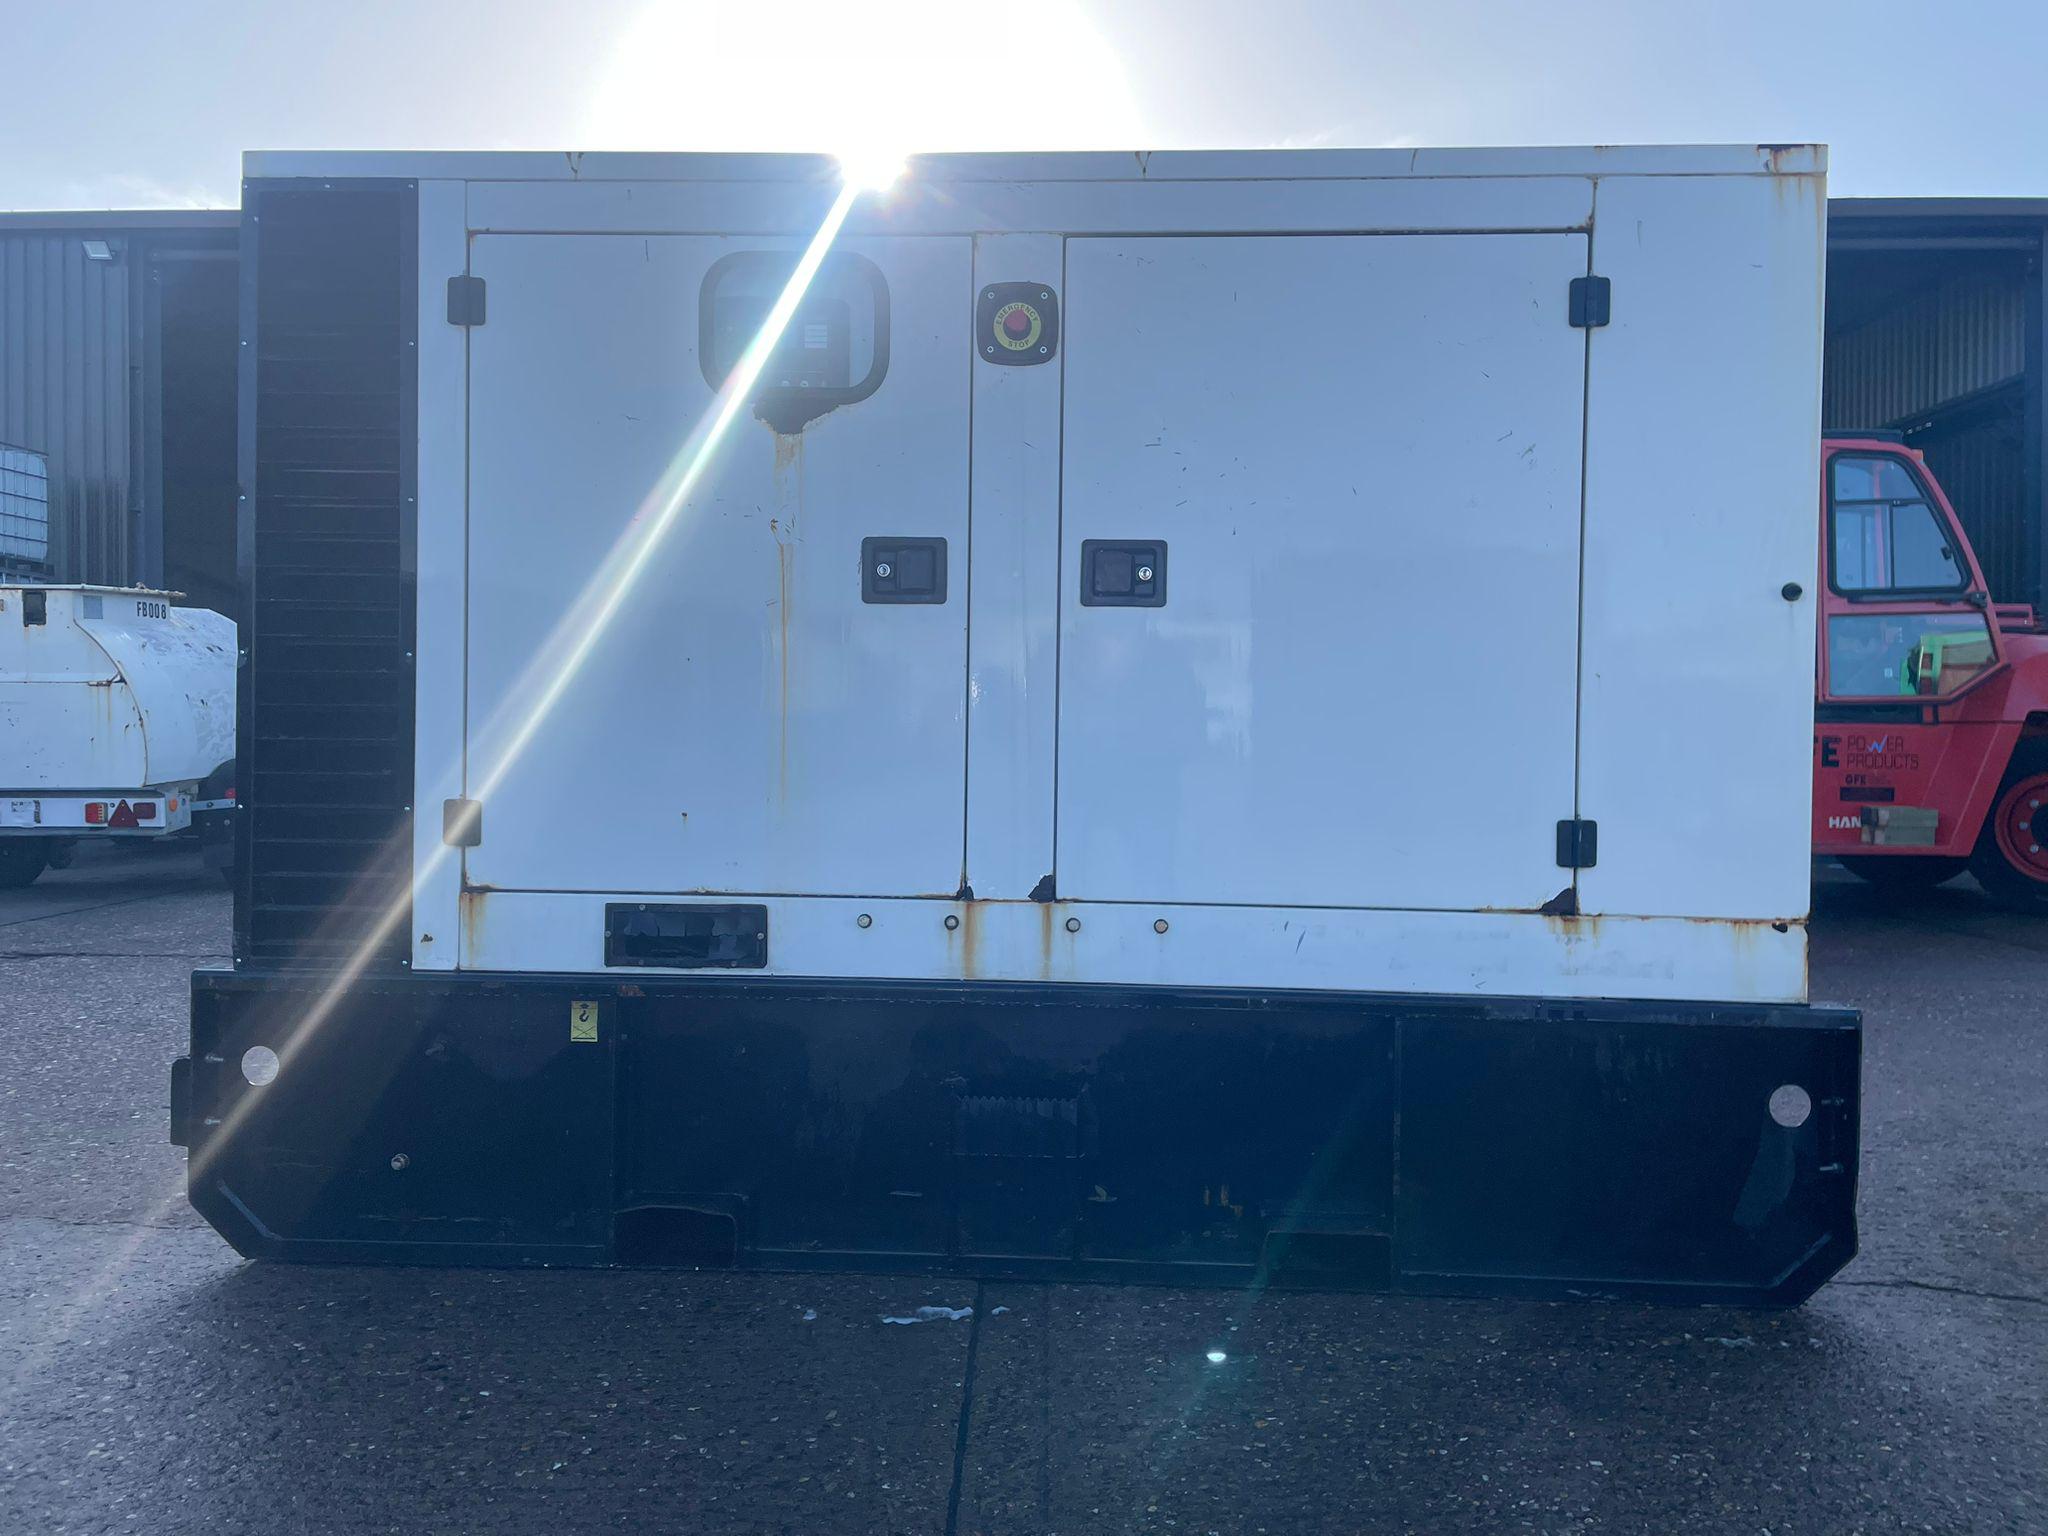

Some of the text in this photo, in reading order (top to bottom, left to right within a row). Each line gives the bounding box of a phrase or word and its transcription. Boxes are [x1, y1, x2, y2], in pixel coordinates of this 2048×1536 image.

[995, 303, 1040, 325] EMERGENCY
[1008, 339, 1031, 349] STOP
[136, 601, 167, 620] FB008
[1847, 734, 1904, 753] POWER
[1846, 752, 1920, 770] PRODUCTS
